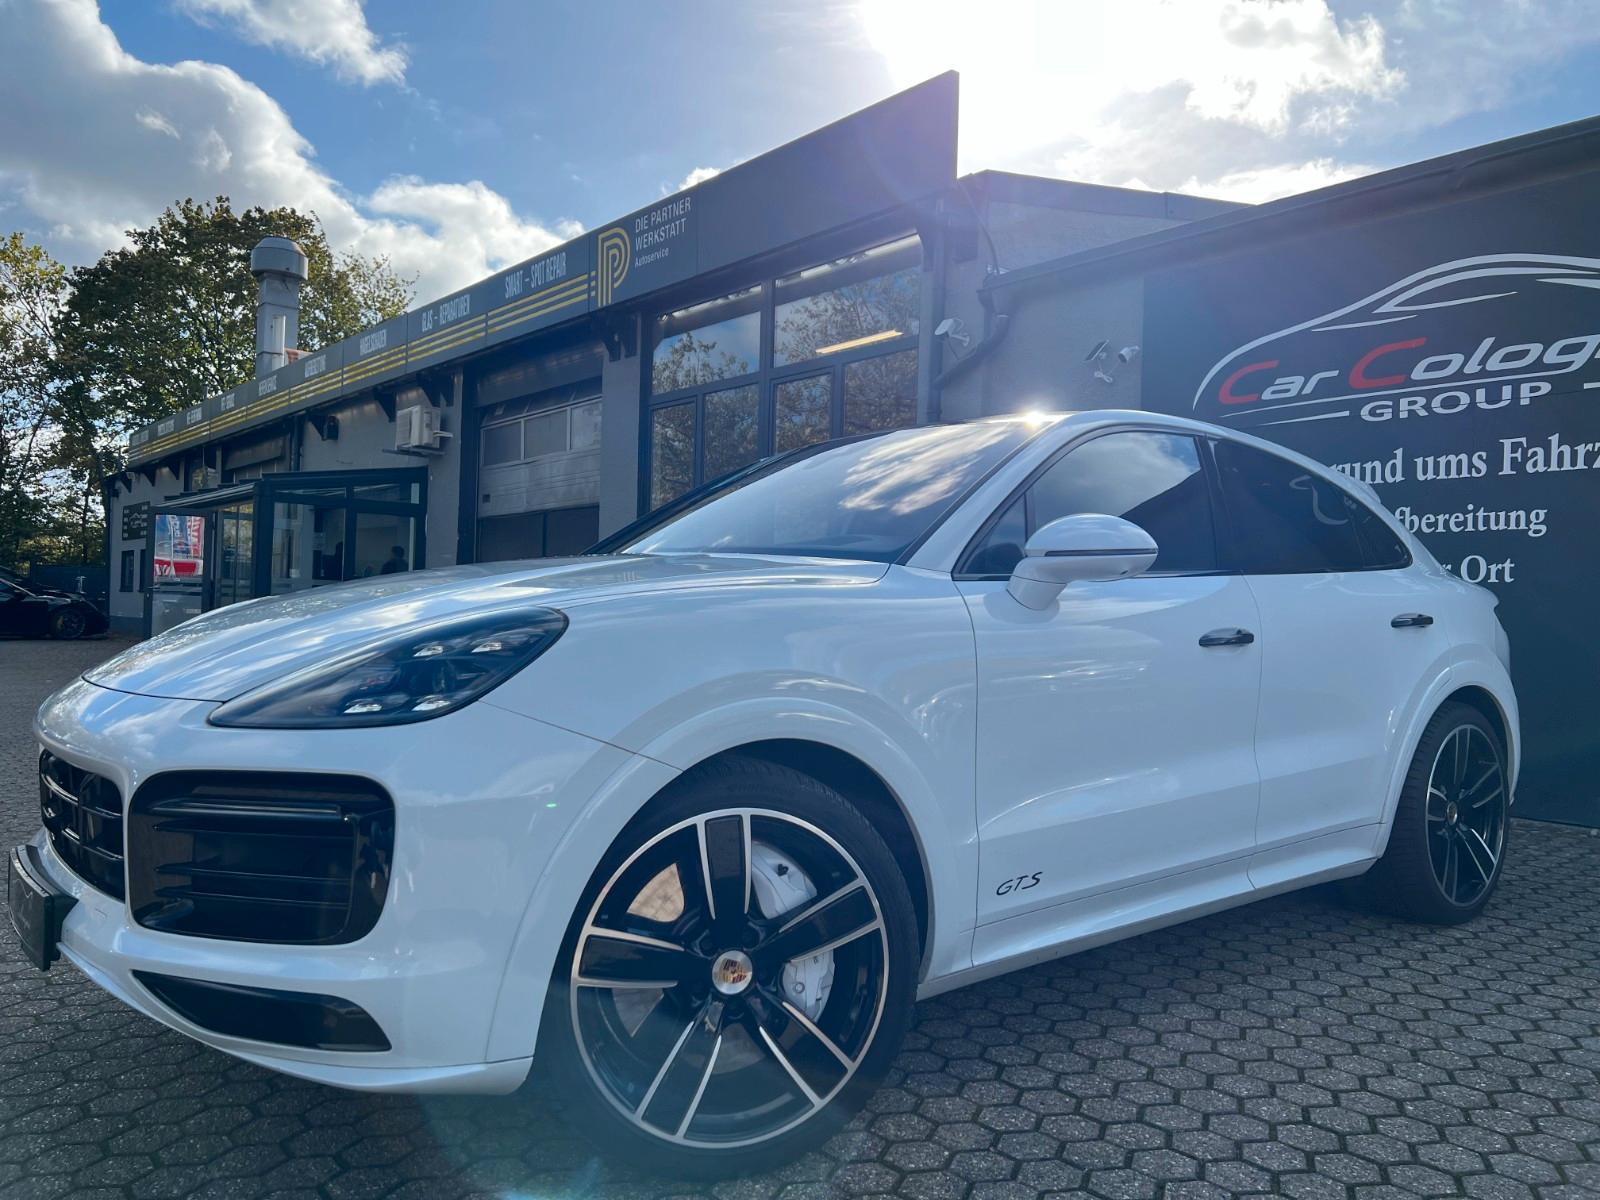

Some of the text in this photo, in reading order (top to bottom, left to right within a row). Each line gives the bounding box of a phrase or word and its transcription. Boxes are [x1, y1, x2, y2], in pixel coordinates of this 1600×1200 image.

[635, 197, 691, 233] DIE PARTNER
[635, 218, 687, 251] WERKSTATT
[505, 270, 524, 299] SMART
[530, 263, 545, 289] SPOT
[546, 251, 567, 283] REPAIR
[1217, 334, 1600, 405] Car Colog
[1360, 381, 1552, 422] GROUP
[1413, 450, 1488, 481] ums
[1394, 503, 1548, 538] fbereitung
[1460, 554, 1515, 583] Ort
[996, 871, 1043, 895] GTS
